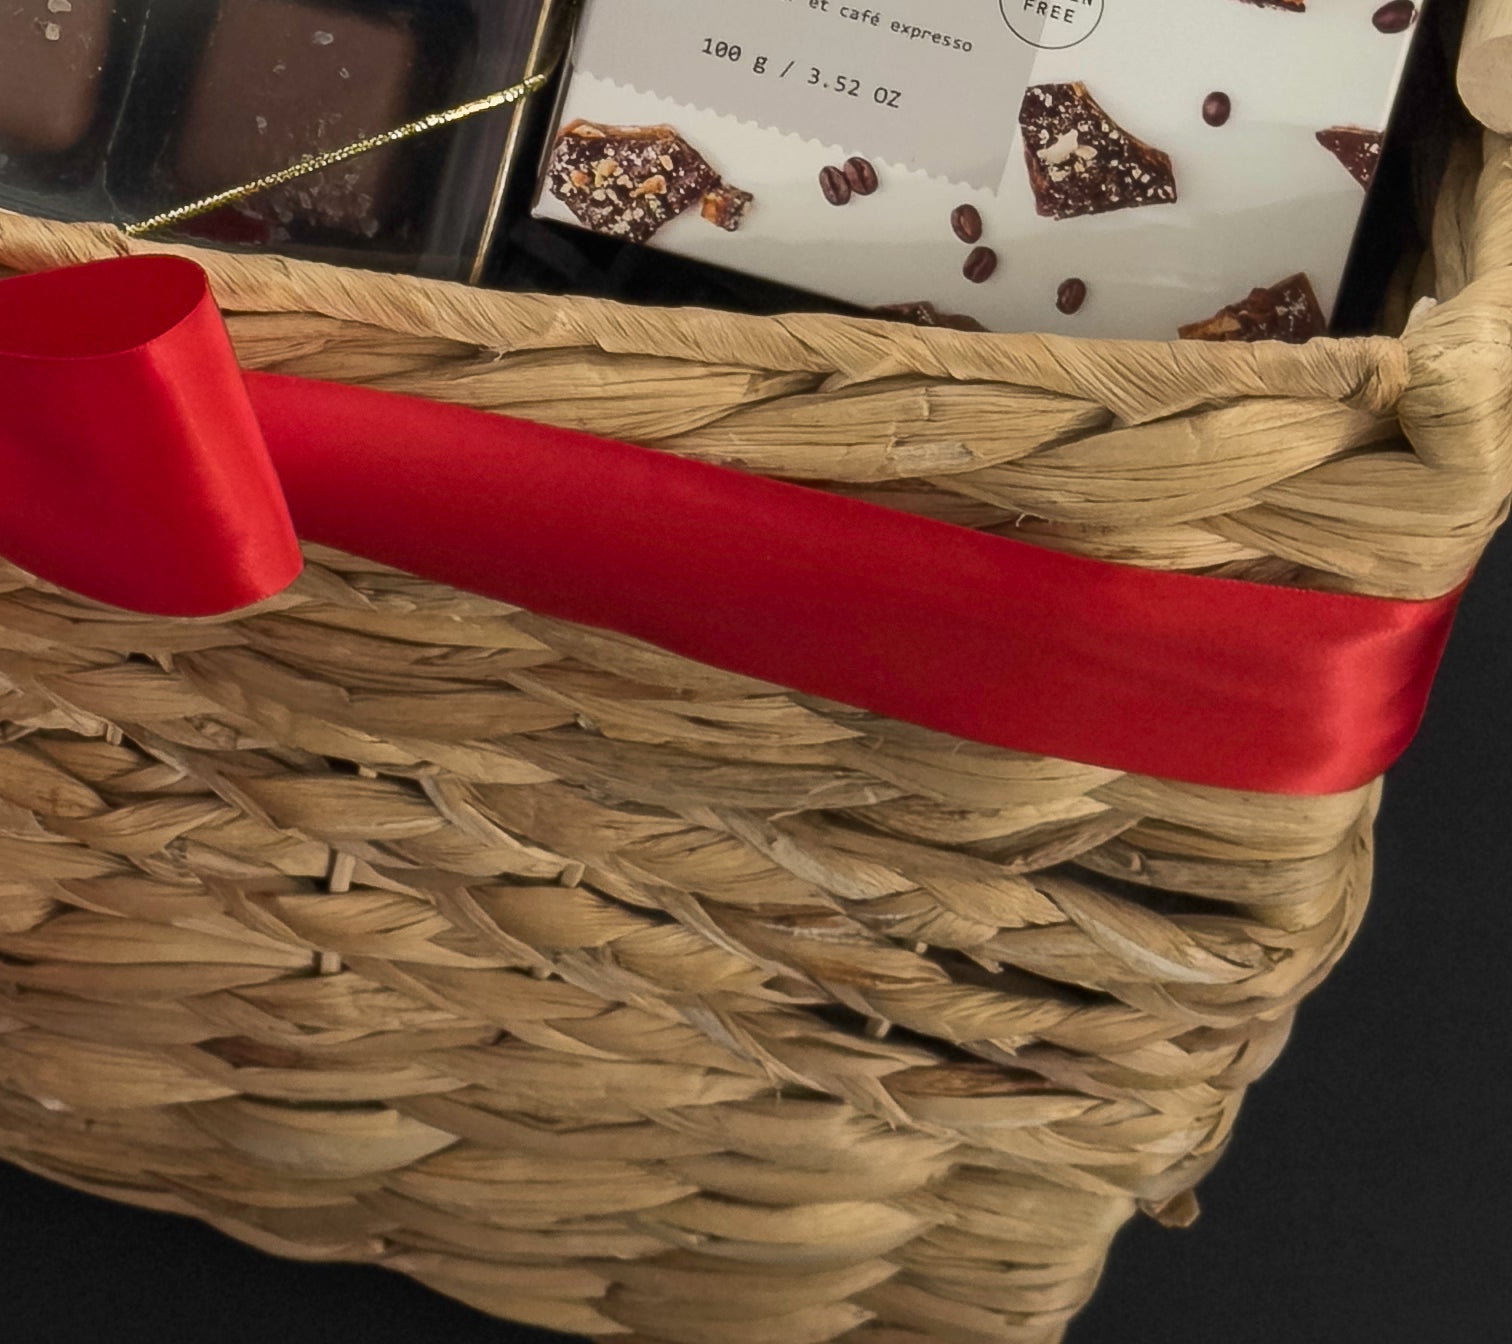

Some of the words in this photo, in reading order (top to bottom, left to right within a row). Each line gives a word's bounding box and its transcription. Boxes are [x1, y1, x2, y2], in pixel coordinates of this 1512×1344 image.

[839, 2, 881, 28] café
[890, 20, 973, 53] expresso
[701, 37, 743, 63] 100
[753, 54, 767, 74] g
[807, 67, 862, 97] 3.52
[873, 86, 903, 109] OZ
